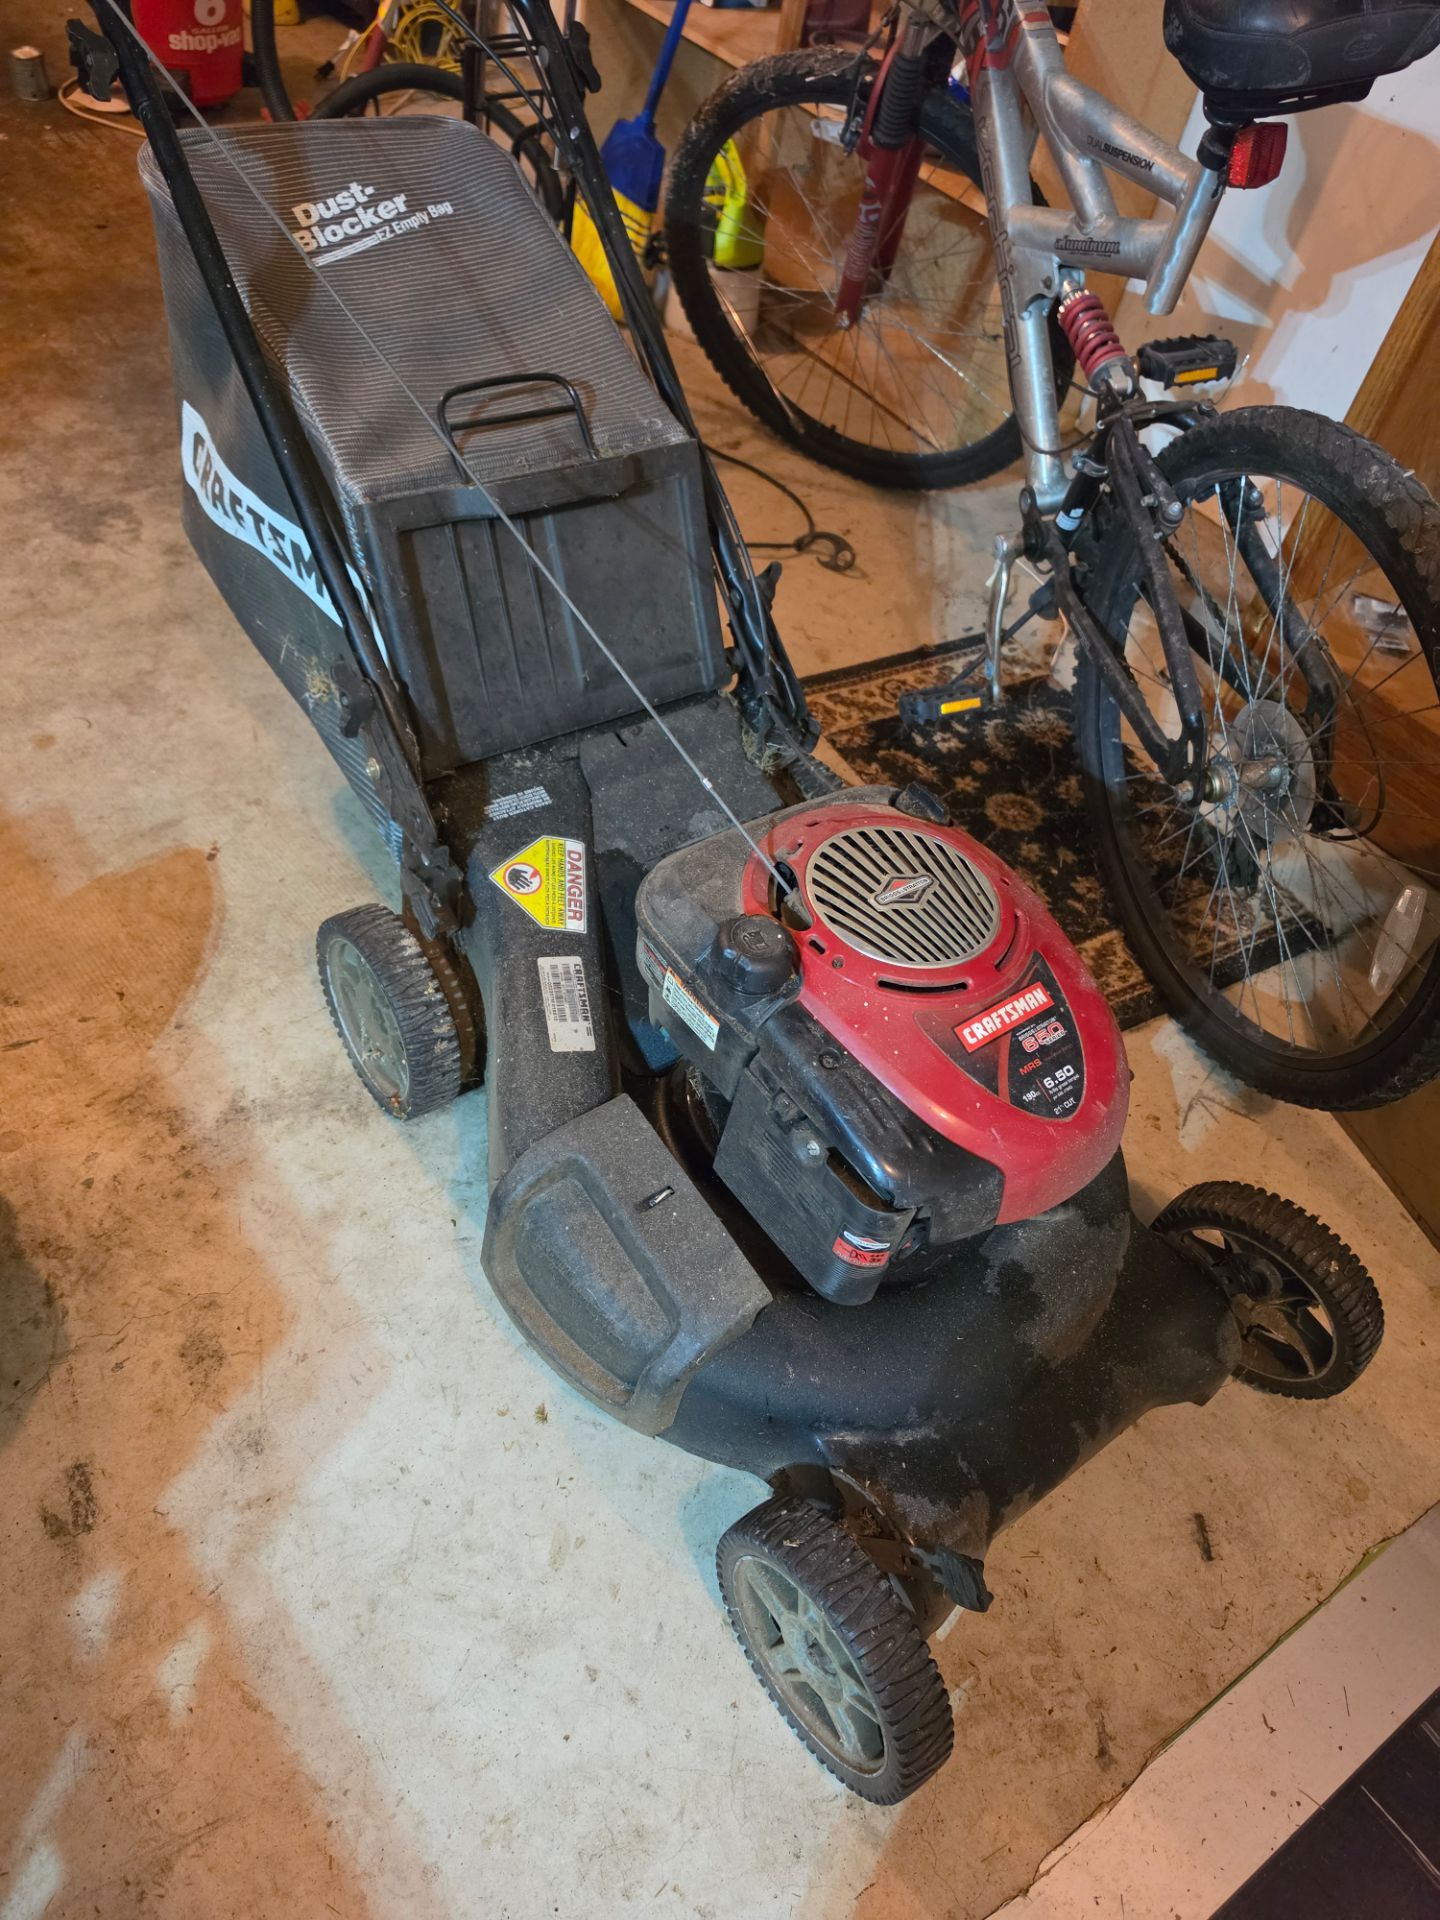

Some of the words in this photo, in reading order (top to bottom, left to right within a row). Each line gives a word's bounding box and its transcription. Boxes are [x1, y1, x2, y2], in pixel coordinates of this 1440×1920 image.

[292, 181, 375, 227] Dust-
[292, 194, 407, 253] Blocker
[375, 226, 394, 241] EZ
[392, 209, 430, 235] Empty
[427, 201, 453, 219] Bag
[192, 431, 331, 599] CRAFTSM
[566, 849, 583, 922] DANGER
[573, 963, 591, 1022] CRAFTSMAN
[962, 987, 1049, 1045] CRAFTSMAN
[1021, 1021, 1064, 1053] 650
[1019, 1058, 1041, 1076] MRS
[1043, 1065, 1074, 1089] 6.50
[1063, 1097, 1077, 1109] CUT
